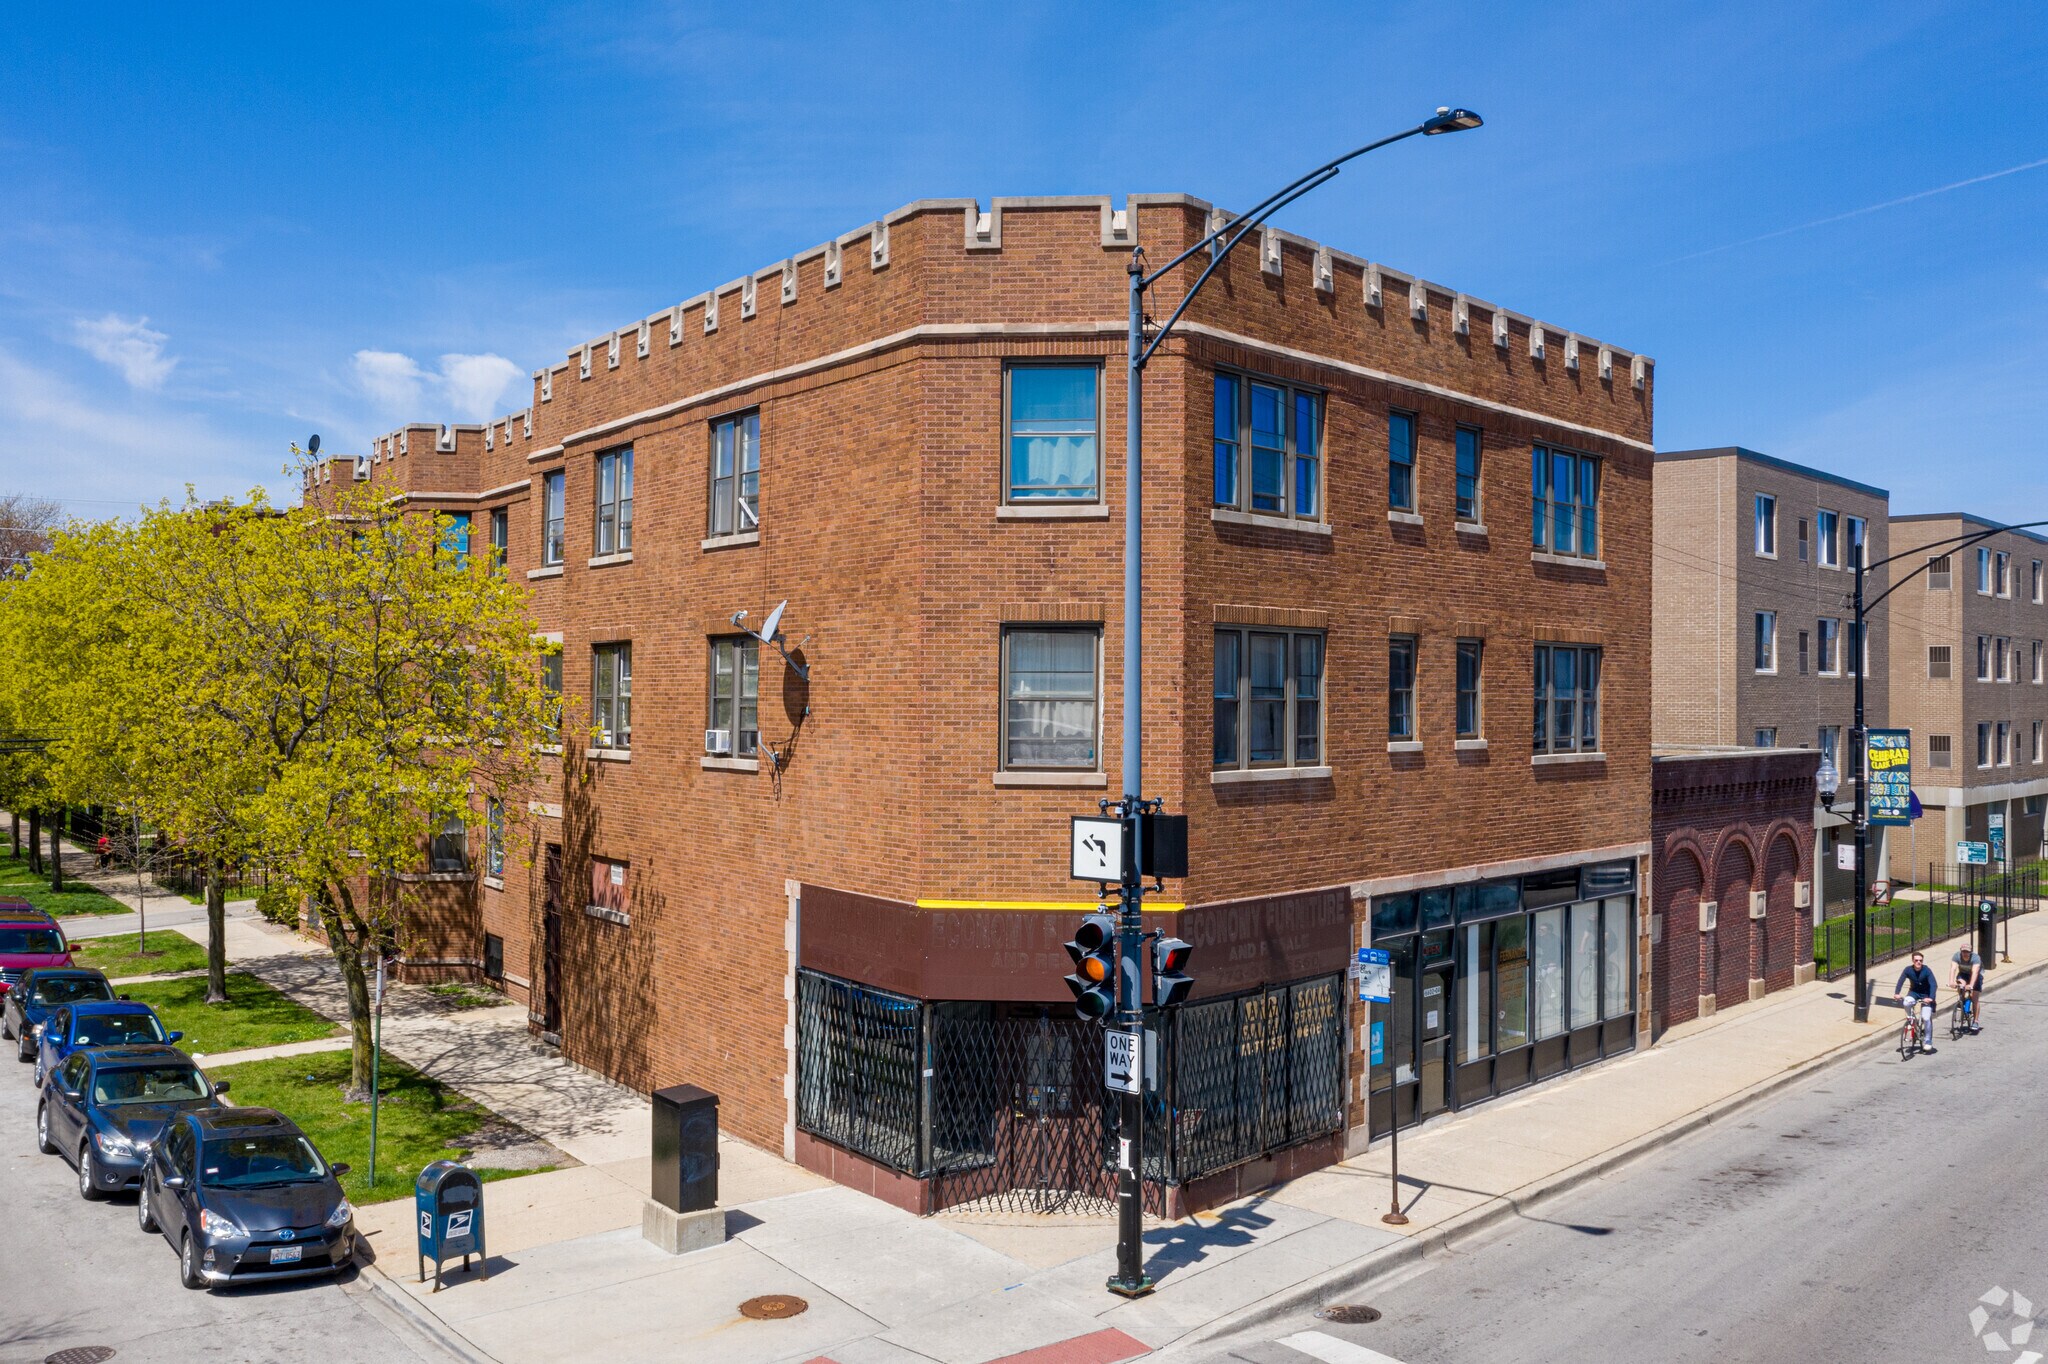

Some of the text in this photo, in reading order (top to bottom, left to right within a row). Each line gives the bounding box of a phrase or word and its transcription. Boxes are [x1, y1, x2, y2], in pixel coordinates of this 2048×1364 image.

[1183, 904, 1261, 948] ECONOMY
[1266, 891, 1345, 930] FURNITURE
[932, 911, 1039, 951] ECONOMY
[1229, 942, 1257, 962] AND
[1110, 1035, 1135, 1052] ONE
[1109, 1052, 1135, 1068] WAY
